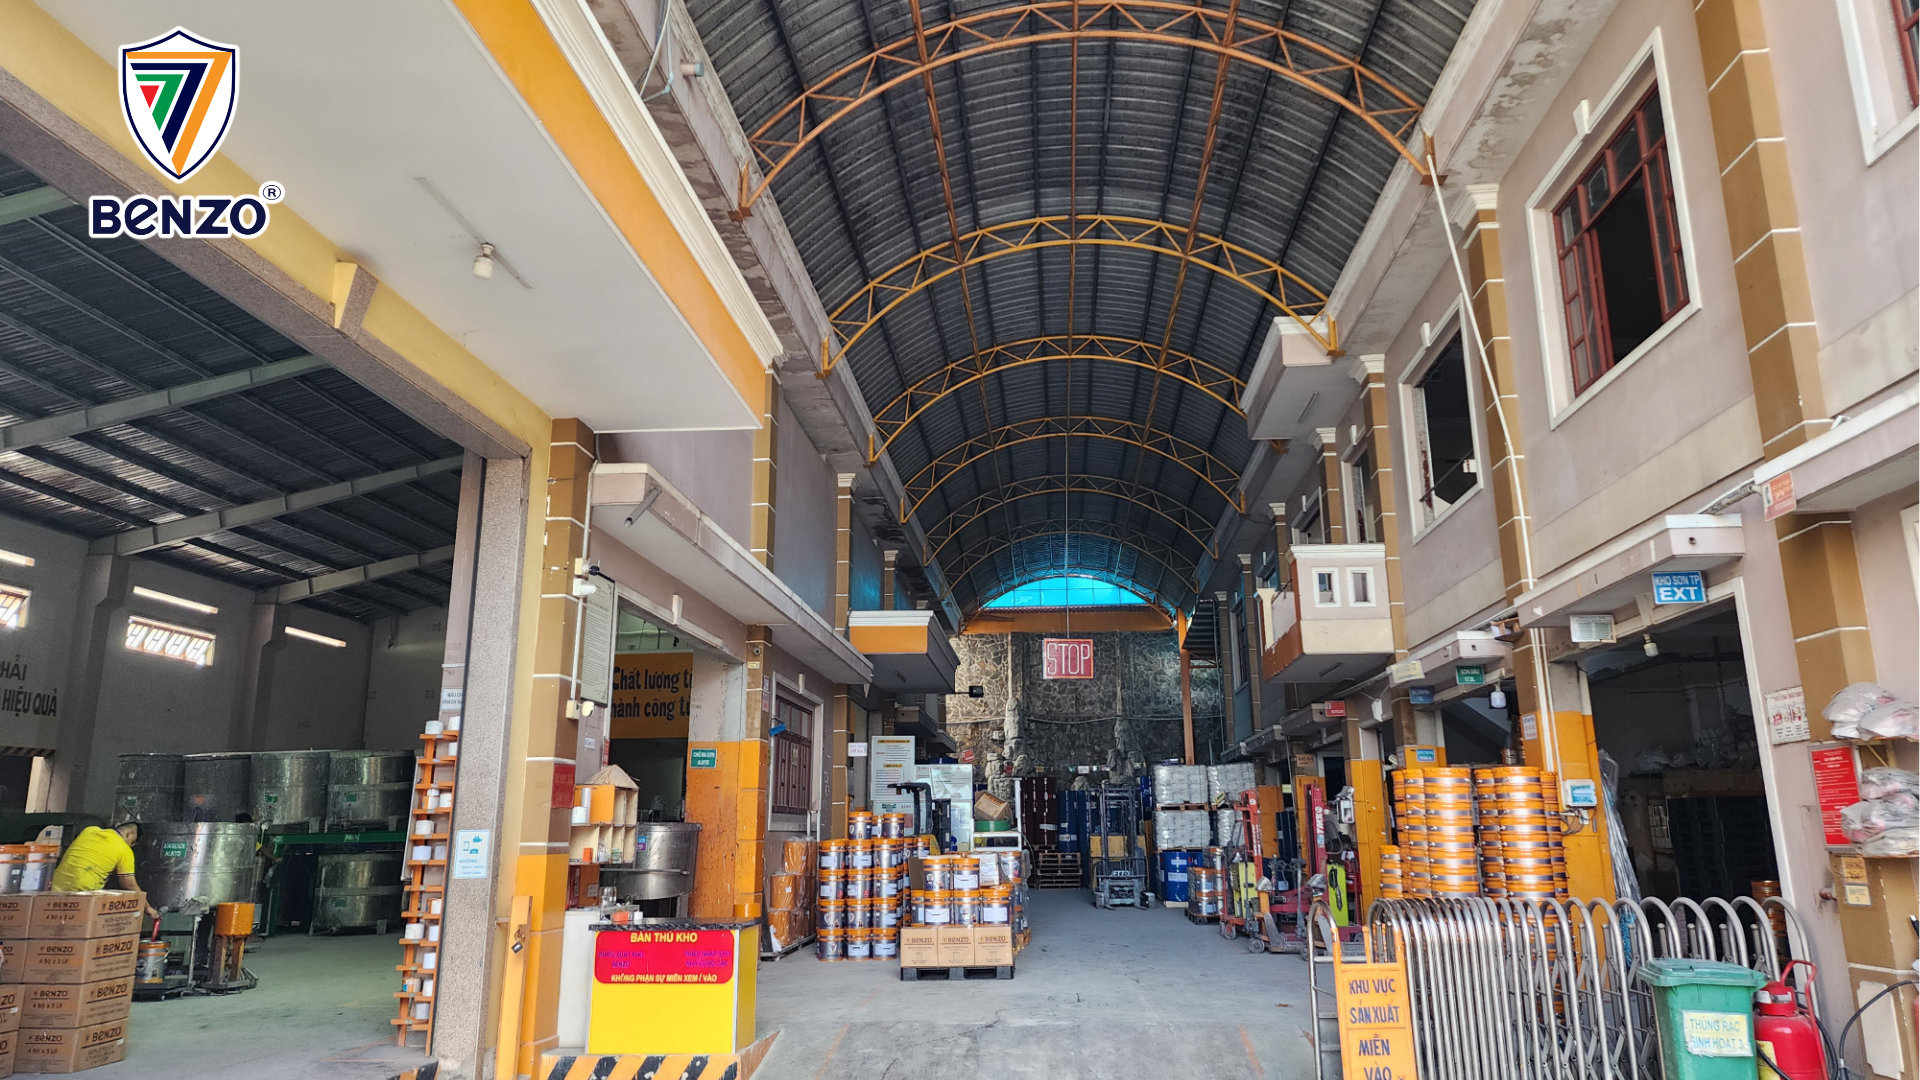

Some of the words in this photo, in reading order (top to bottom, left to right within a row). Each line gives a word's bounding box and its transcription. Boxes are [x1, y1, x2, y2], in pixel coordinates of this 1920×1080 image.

[1655, 576, 1671, 585] KHO
[1689, 575, 1699, 585] TP
[1659, 586, 1698, 600] EXT
[0, 654, 27, 681] HẢI
[1047, 642, 1090, 675] STOP
[1412, 662, 1417, 671] 2
[612, 667, 641, 690] Chất
[644, 669, 680, 693] lượng
[2, 686, 32, 717] HIỆU
[33, 688, 57, 717] QUẢ
[644, 698, 676, 721] công
[630, 931, 651, 943] BÀN
[654, 931, 674, 943] THỦ
[676, 932, 698, 943] KHO
[611, 973, 635, 982] KHÔNG
[683, 974, 698, 982] XEM
[702, 973, 718, 982] VÀO
[1349, 979, 1370, 995] KHU
[1372, 976, 1396, 996] VỰC
[1349, 999, 1372, 1024] SẢN
[1372, 999, 1400, 1024] XUẤT
[1359, 1033, 1390, 1056] MIỄN
[1691, 1036, 1711, 1049] SINH
[1738, 1038, 1744, 1049] 3
